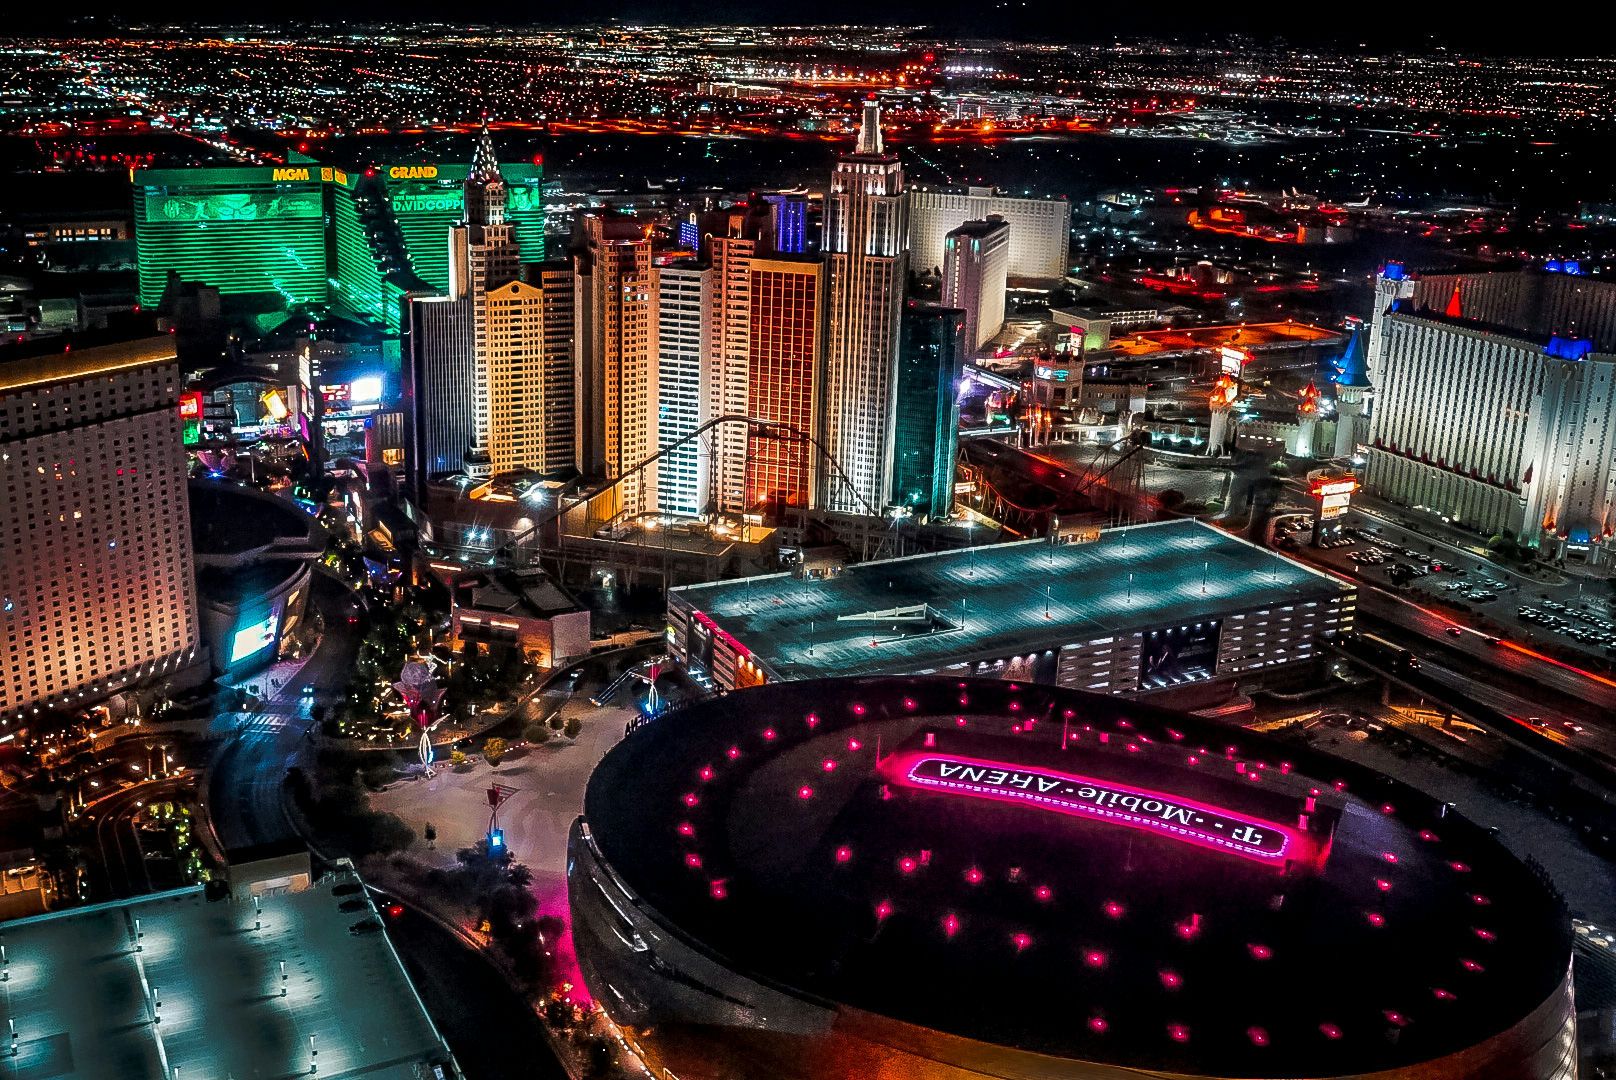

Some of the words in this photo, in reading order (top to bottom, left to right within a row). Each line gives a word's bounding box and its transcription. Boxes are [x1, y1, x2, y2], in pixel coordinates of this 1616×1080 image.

[272, 168, 310, 181] MGM
[389, 166, 438, 179] GRAND
[940, 763, 1061, 793] ARENA
